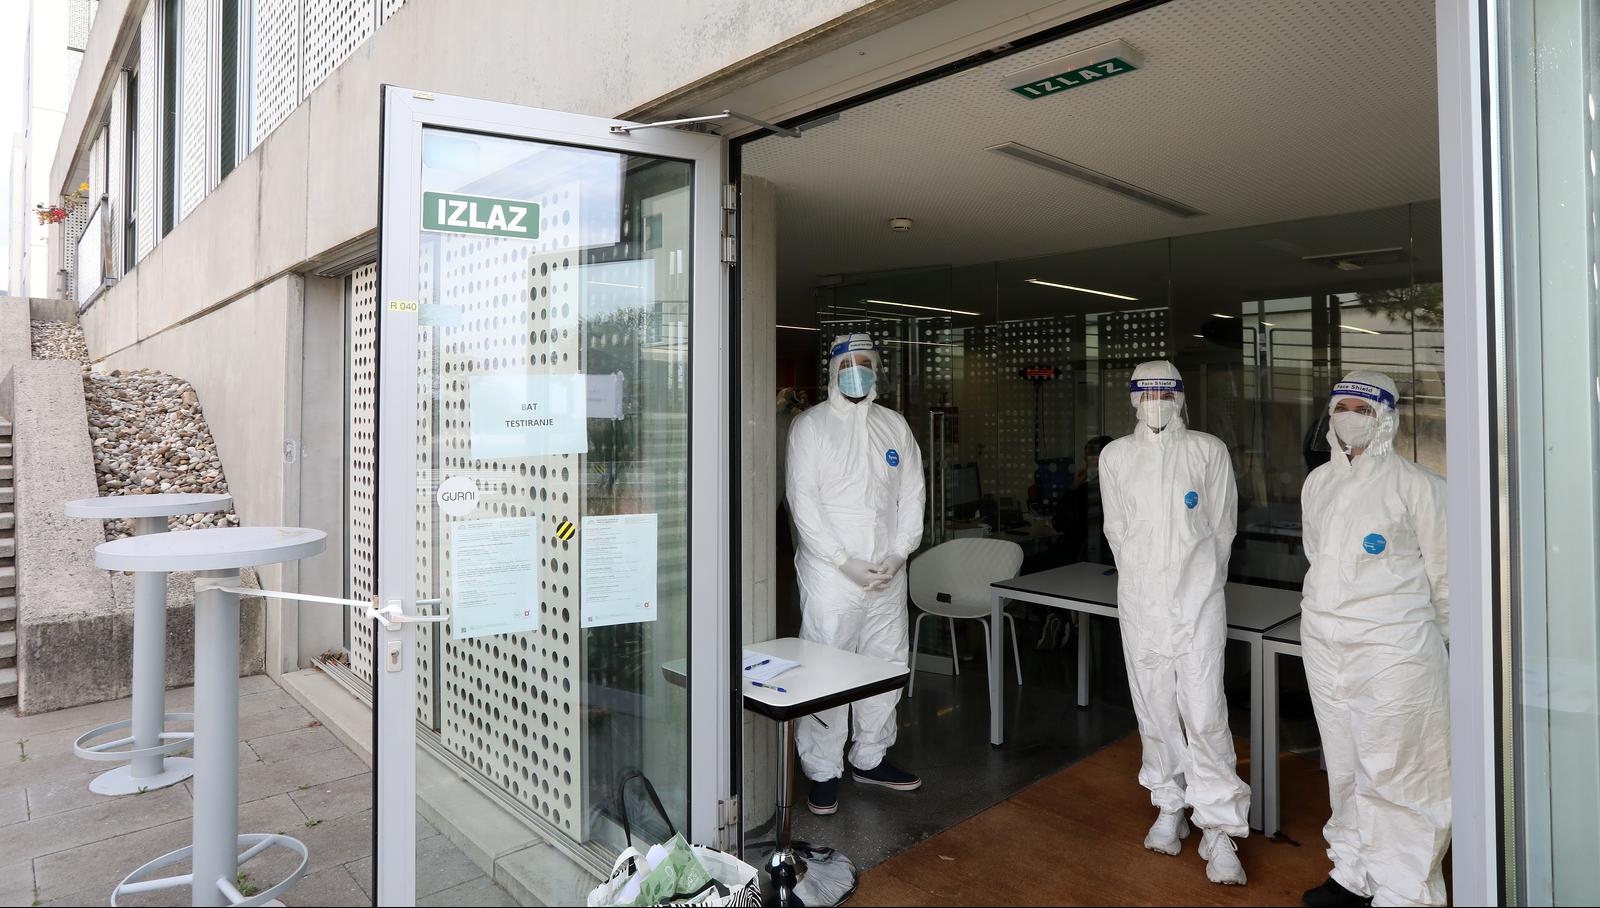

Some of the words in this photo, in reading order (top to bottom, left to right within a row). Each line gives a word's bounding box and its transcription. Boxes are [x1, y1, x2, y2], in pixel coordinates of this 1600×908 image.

[1023, 62, 1124, 95] IZLAZ
[438, 198, 527, 233] IZLAZ
[390, 301, 398, 310] R
[399, 302, 417, 311] 040
[1350, 384, 1373, 393] Shield
[521, 403, 538, 411] BAT
[505, 418, 554, 428] TESTIRANJE
